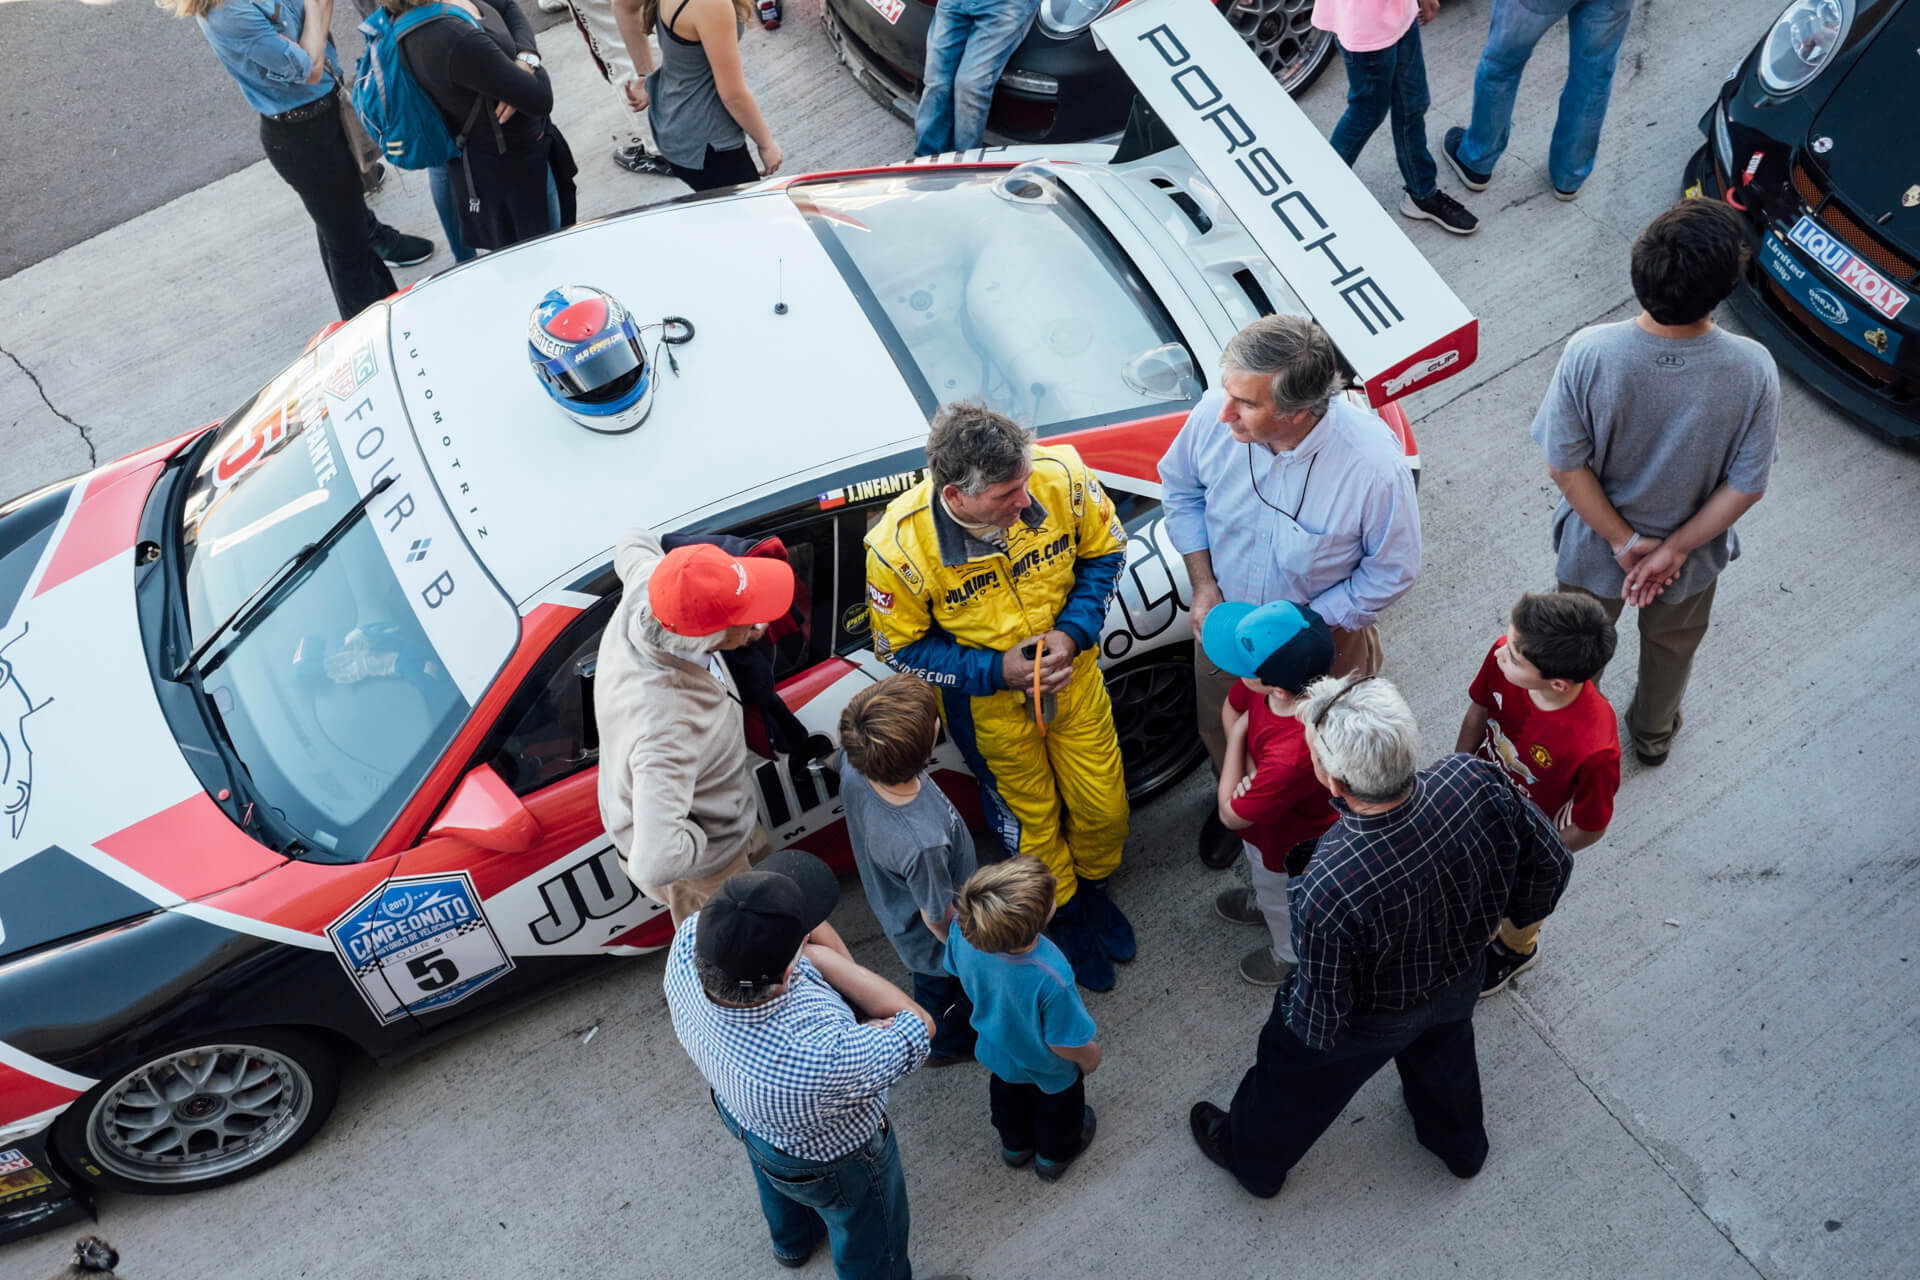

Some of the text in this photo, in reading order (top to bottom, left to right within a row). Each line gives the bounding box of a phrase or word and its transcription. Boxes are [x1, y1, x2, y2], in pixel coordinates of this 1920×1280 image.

[1137, 23, 1405, 336] PORSCHE
[1766, 237, 1806, 280] Limited
[1772, 259, 1791, 282] Slip
[1793, 221, 1849, 271] LIQUI
[1841, 259, 1905, 311] MOLY
[1427, 352, 1457, 372] CUP
[402, 330, 488, 540] AUTOMOTRIZ
[345, 397, 455, 609] FOUR B
[846, 470, 917, 503] J.INFANTE
[388, 898, 406, 911] 2017
[350, 896, 469, 961] CAMPEONATO
[408, 931, 419, 942] DE
[383, 942, 430, 963] FOUR
[406, 948, 459, 991] 5
